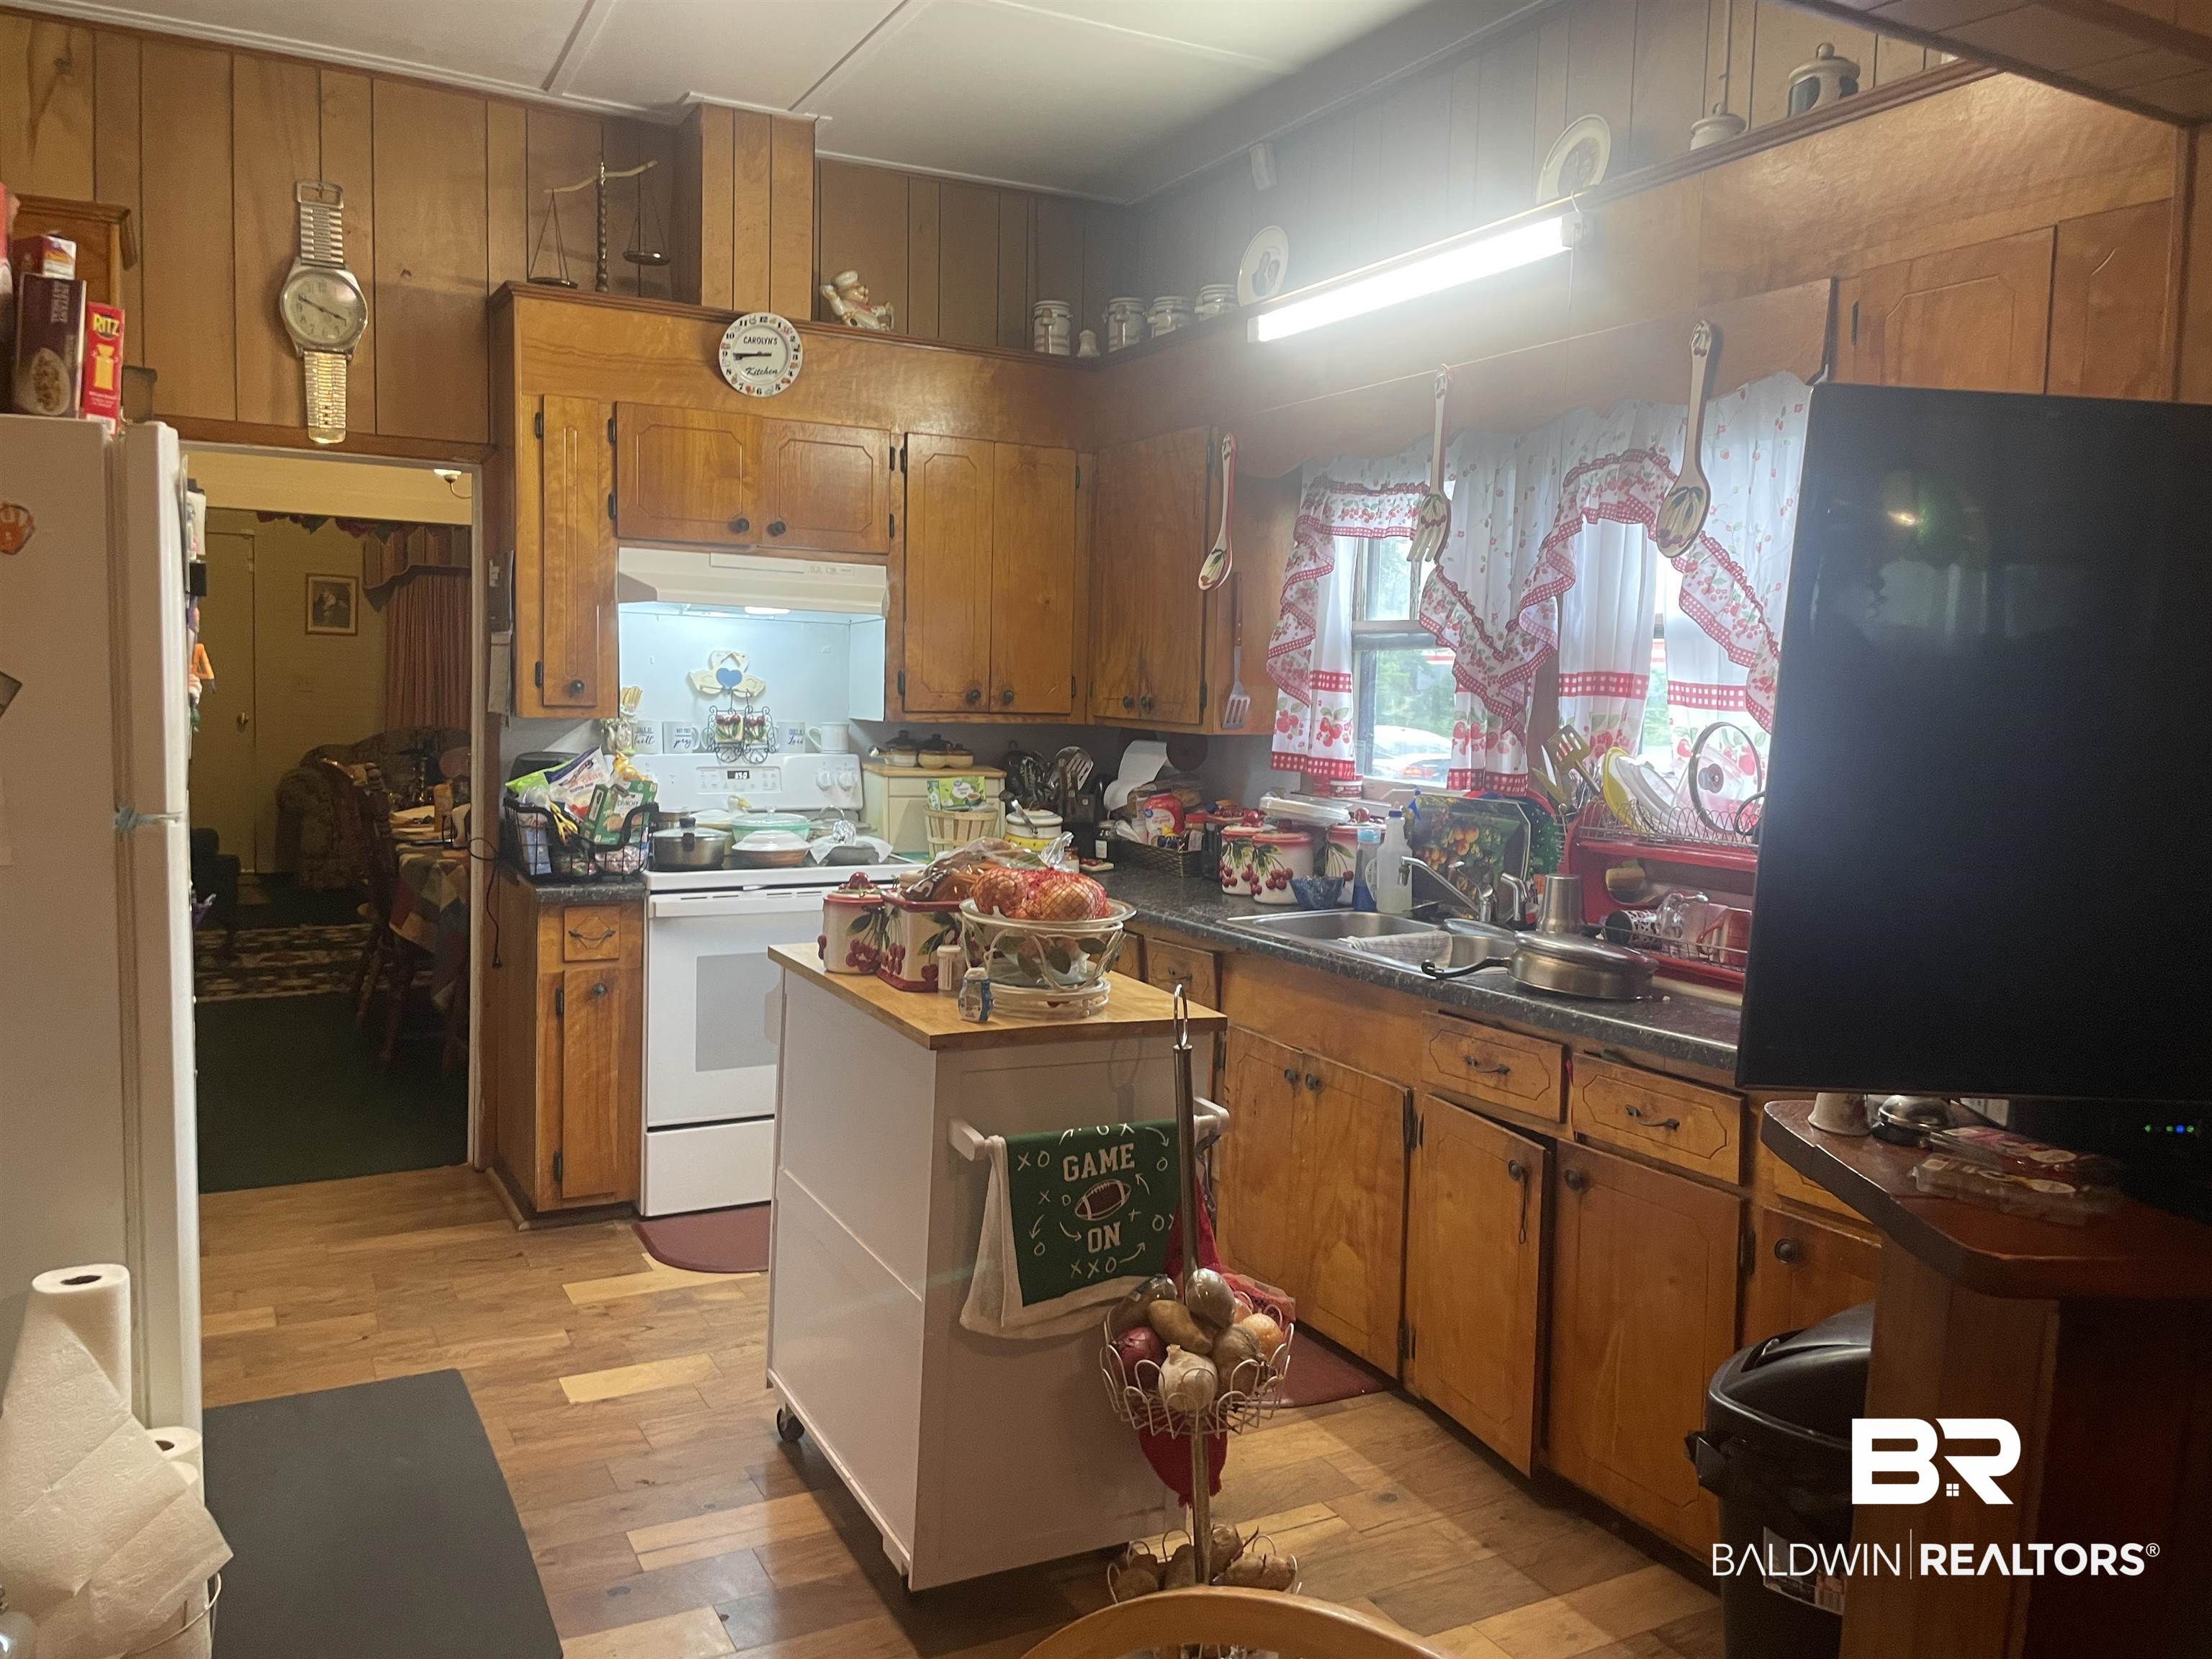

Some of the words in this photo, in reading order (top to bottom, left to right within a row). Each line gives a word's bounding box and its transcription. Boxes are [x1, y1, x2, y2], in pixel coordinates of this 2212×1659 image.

[92, 313, 120, 337] RITZ
[745, 366, 778, 376] Kitchen
[1062, 1143, 1136, 1182] GAME
[1087, 1222, 1121, 1254] ON
